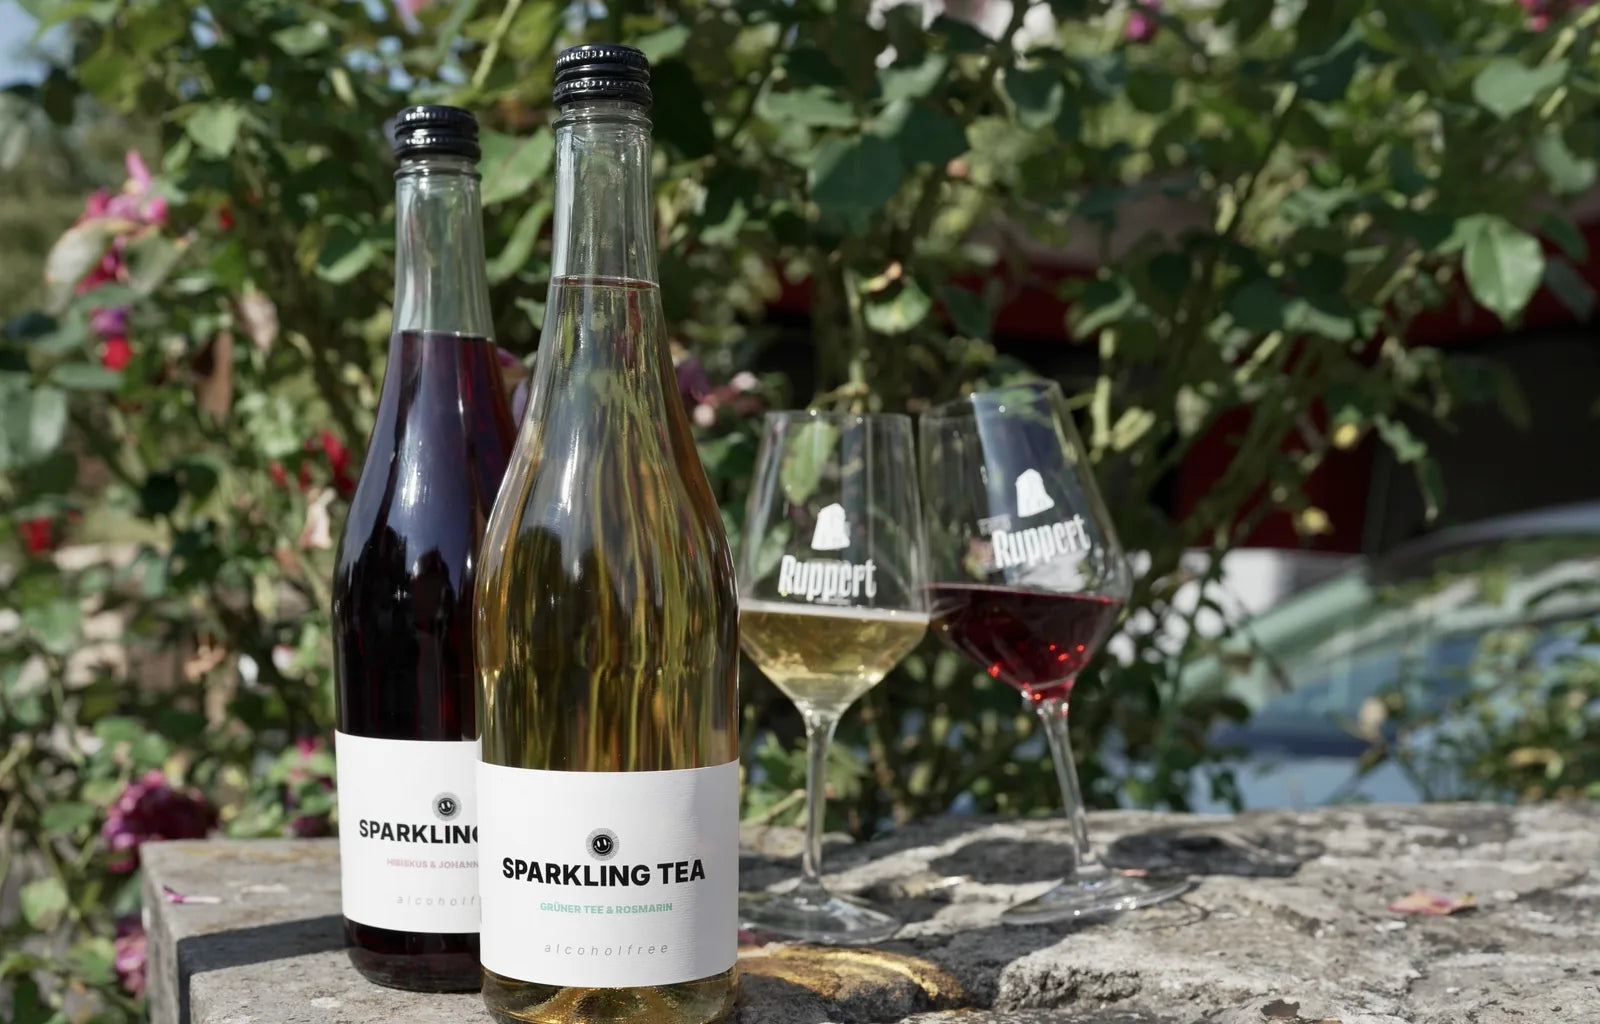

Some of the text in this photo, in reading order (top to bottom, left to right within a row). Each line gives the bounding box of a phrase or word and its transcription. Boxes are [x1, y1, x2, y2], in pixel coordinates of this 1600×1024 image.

[991, 514, 1092, 569] Ruppert
[778, 554, 877, 602] Ruppert
[386, 858, 428, 869] HIBISKUS
[430, 860, 437, 868] &
[502, 857, 706, 887] SPARKLING TEA
[540, 901, 673, 914] GRÜNER TEE & ROSMARIN
[544, 943, 668, 956] alcoholfree
